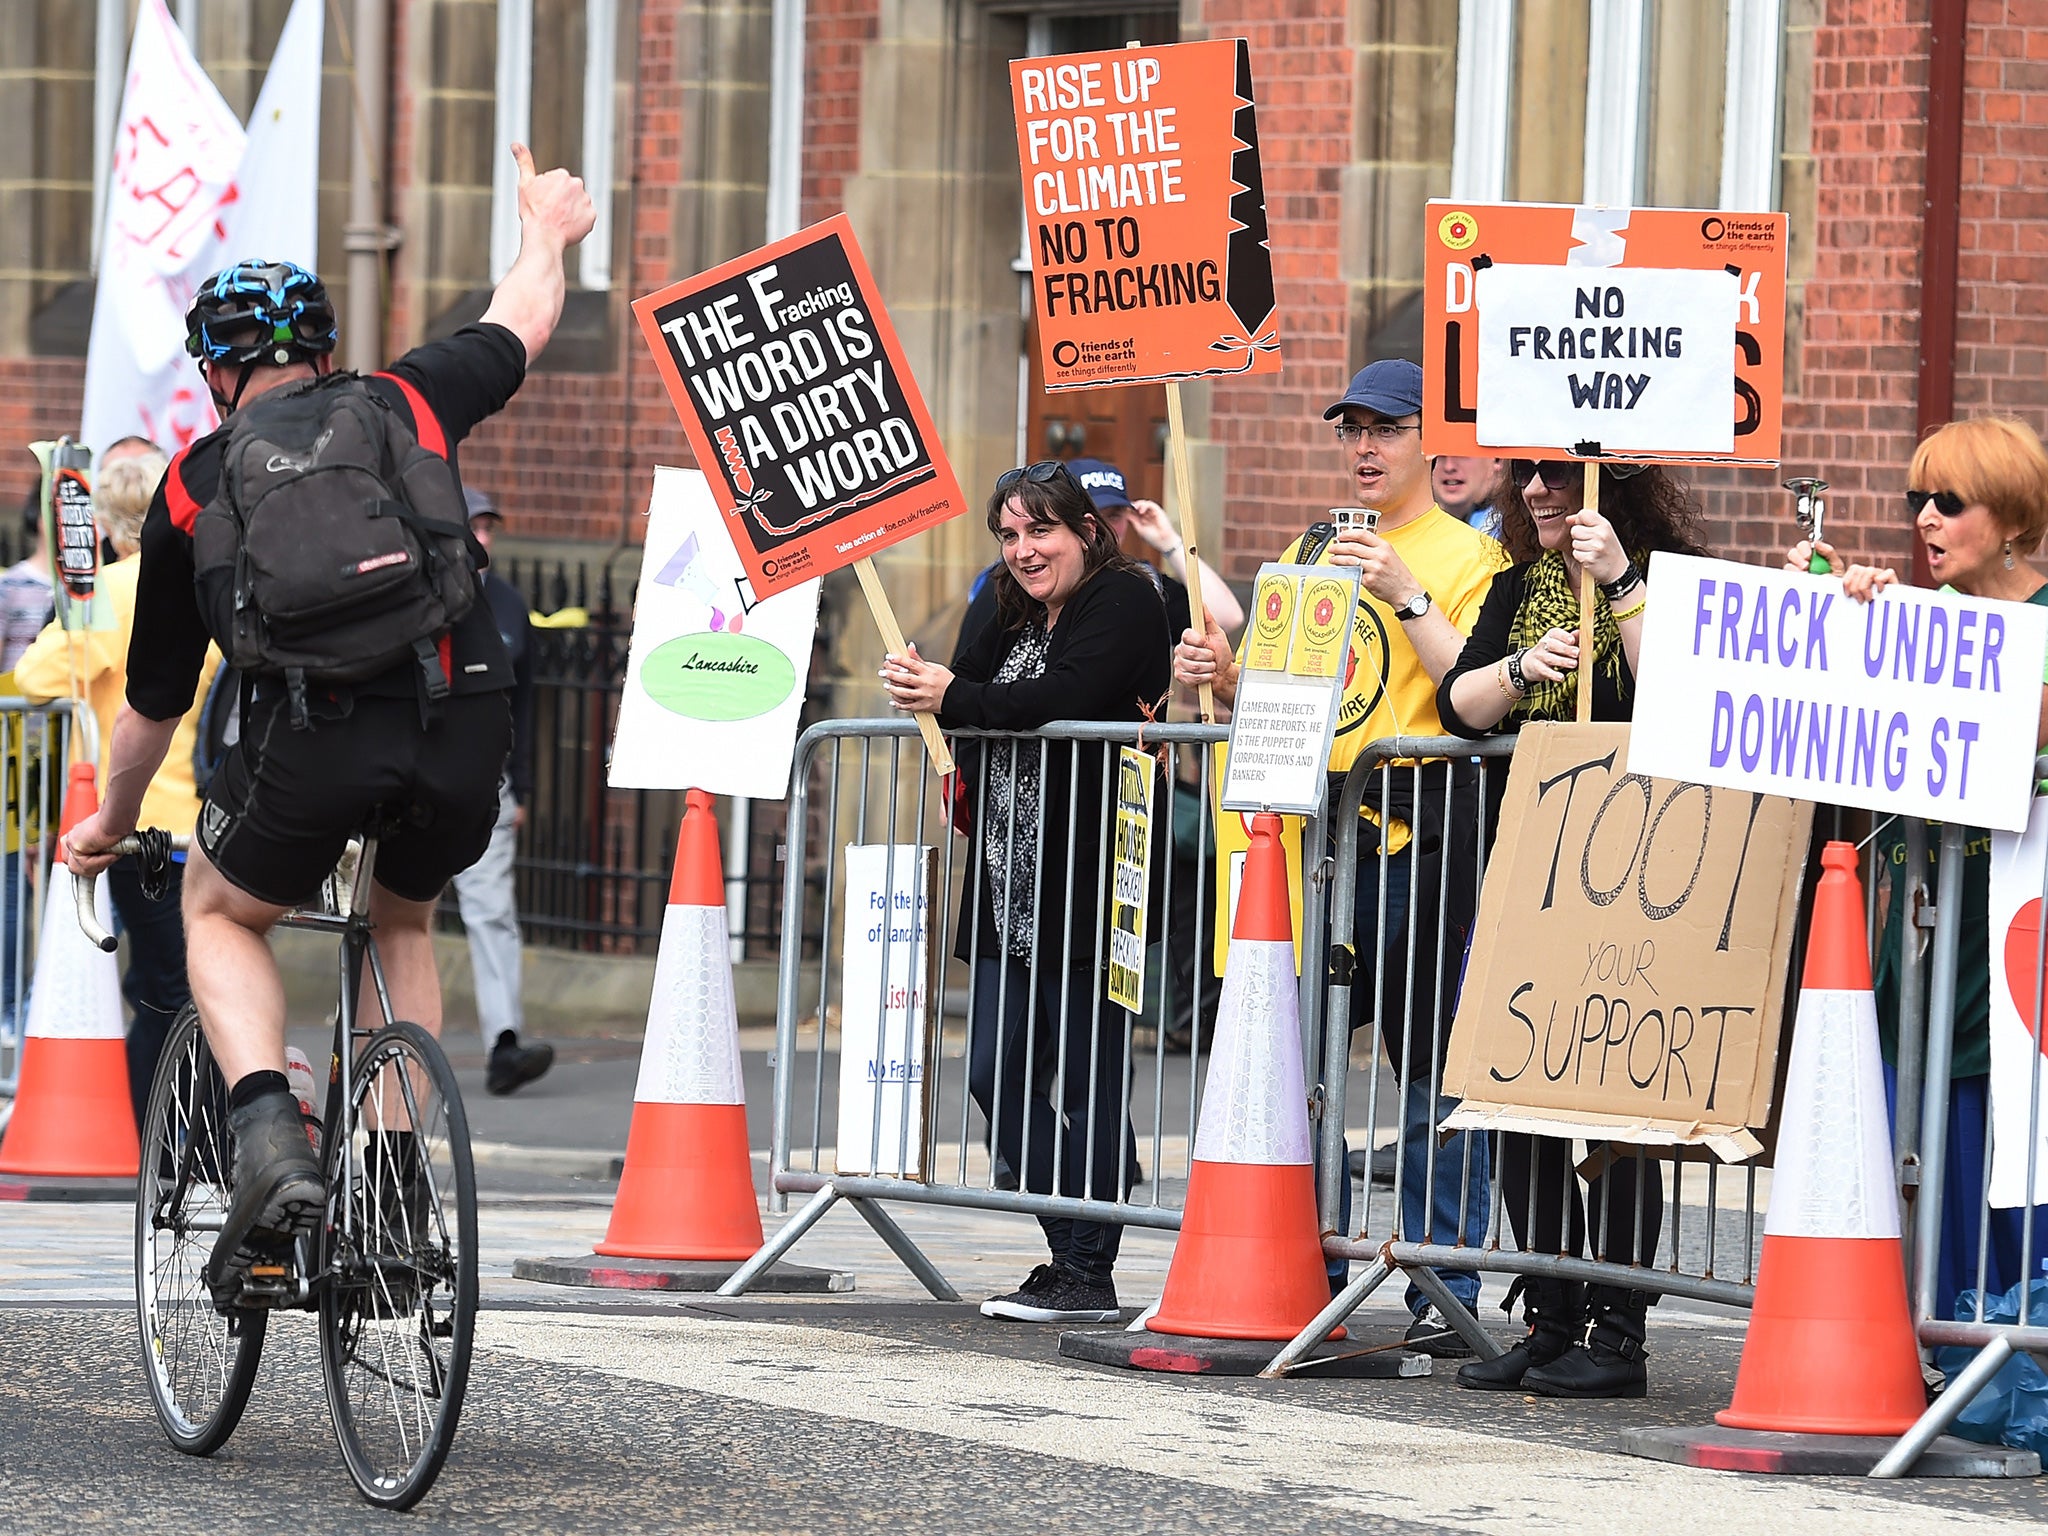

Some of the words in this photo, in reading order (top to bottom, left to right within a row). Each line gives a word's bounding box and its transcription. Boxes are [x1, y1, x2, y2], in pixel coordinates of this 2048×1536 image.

[1021, 63, 1106, 114] RISE
[1112, 58, 1161, 104] UP
[1027, 115, 1102, 165] FOR
[1105, 107, 1181, 157] THE
[1033, 159, 1186, 216] CLIMATE
[1039, 221, 1088, 267] NO
[1095, 216, 1141, 261] TO
[1727, 221, 1762, 231] friends
[1764, 222, 1775, 231] of
[1727, 232, 1744, 240] the
[1747, 232, 1775, 240] earth
[1044, 260, 1222, 317] FRACKING
[1575, 286, 1625, 319] NO
[661, 294, 755, 368] THE
[746, 264, 855, 333] Fracking
[1080, 340, 1120, 352] friends
[1122, 338, 1134, 348] of
[1082, 353, 1101, 363] the
[1104, 349, 1136, 361] earth
[1509, 326, 1682, 360] FRACKING
[690, 328, 828, 421] WORD
[823, 308, 875, 366] IS
[1056, 370, 1070, 378] see
[1072, 367, 1096, 377] things
[1097, 362, 1137, 374] differently
[1567, 371, 1651, 410] WAY
[740, 414, 779, 469] A
[770, 359, 892, 454] DIRTY
[782, 417, 920, 510] WORD
[1081, 471, 1125, 490] POLICE
[834, 541, 854, 555] Take
[853, 532, 877, 548] action
[876, 526, 886, 537] at
[884, 499, 950, 534] foe.co.uk/fracking
[777, 551, 801, 565] friends
[780, 562, 792, 571] the
[792, 553, 811, 565] earth
[1312, 584, 1330, 596] FRACK
[1330, 584, 1342, 598] FREE
[1259, 620, 1284, 633] LANCASHIRE
[1306, 624, 1336, 639] LANCASHIRE
[1693, 579, 1835, 671] FRACK
[1863, 600, 2006, 692] UNDER
[681, 652, 759, 675] Lancashire
[1241, 701, 1280, 713] CAMERON
[1281, 703, 1316, 716] REJECTS
[1237, 735, 1243, 746] IS
[1245, 735, 1261, 747] THE
[1261, 736, 1295, 749] PUPPET
[1295, 738, 1306, 749] OF
[1239, 718, 1269, 730] EXPERT
[1270, 720, 1307, 732] REPORTS.
[1309, 721, 1322, 733] HE
[1234, 752, 1295, 767] CORPORATIONS
[1295, 755, 1314, 767] AND
[1709, 690, 1909, 791] DOWNING
[1927, 717, 1980, 800] ST
[1232, 769, 1267, 781] BANKERS
[1116, 817, 1146, 868] HOUSES
[1537, 746, 1795, 952] TOOT
[1115, 862, 1143, 903] FRACKED
[894, 890, 911, 909] the
[868, 923, 882, 942] of
[1581, 940, 1659, 996] YOUR
[1490, 982, 1755, 1112] SUPPORT
